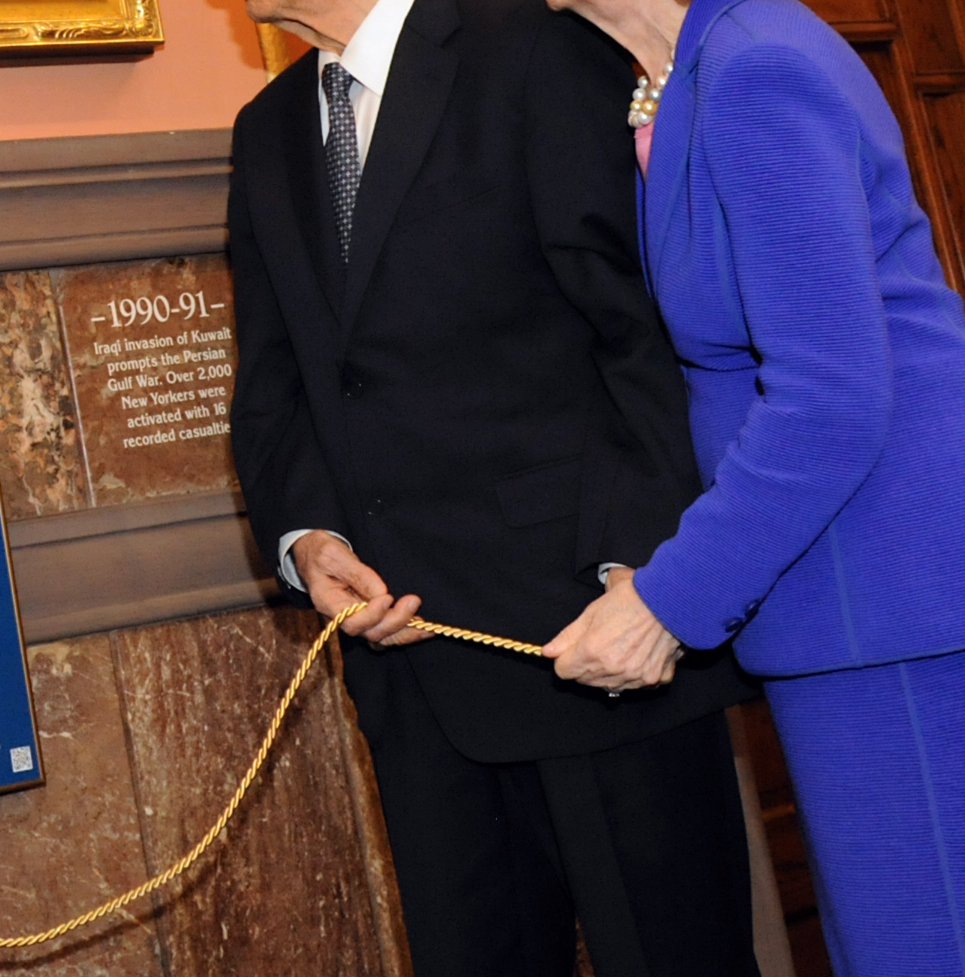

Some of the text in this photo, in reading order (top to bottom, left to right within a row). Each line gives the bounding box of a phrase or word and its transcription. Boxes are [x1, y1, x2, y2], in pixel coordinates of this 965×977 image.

[93, 327, 232, 357] Iraqi invasion of Kuwait
[107, 349, 226, 375] prompts the Persian
[107, 364, 232, 392] Gulf War. Over 2,000
[122, 386, 226, 410] New Yorkers were
[127, 403, 227, 428] activated with 16
[124, 421, 231, 448] recorded casualtie
